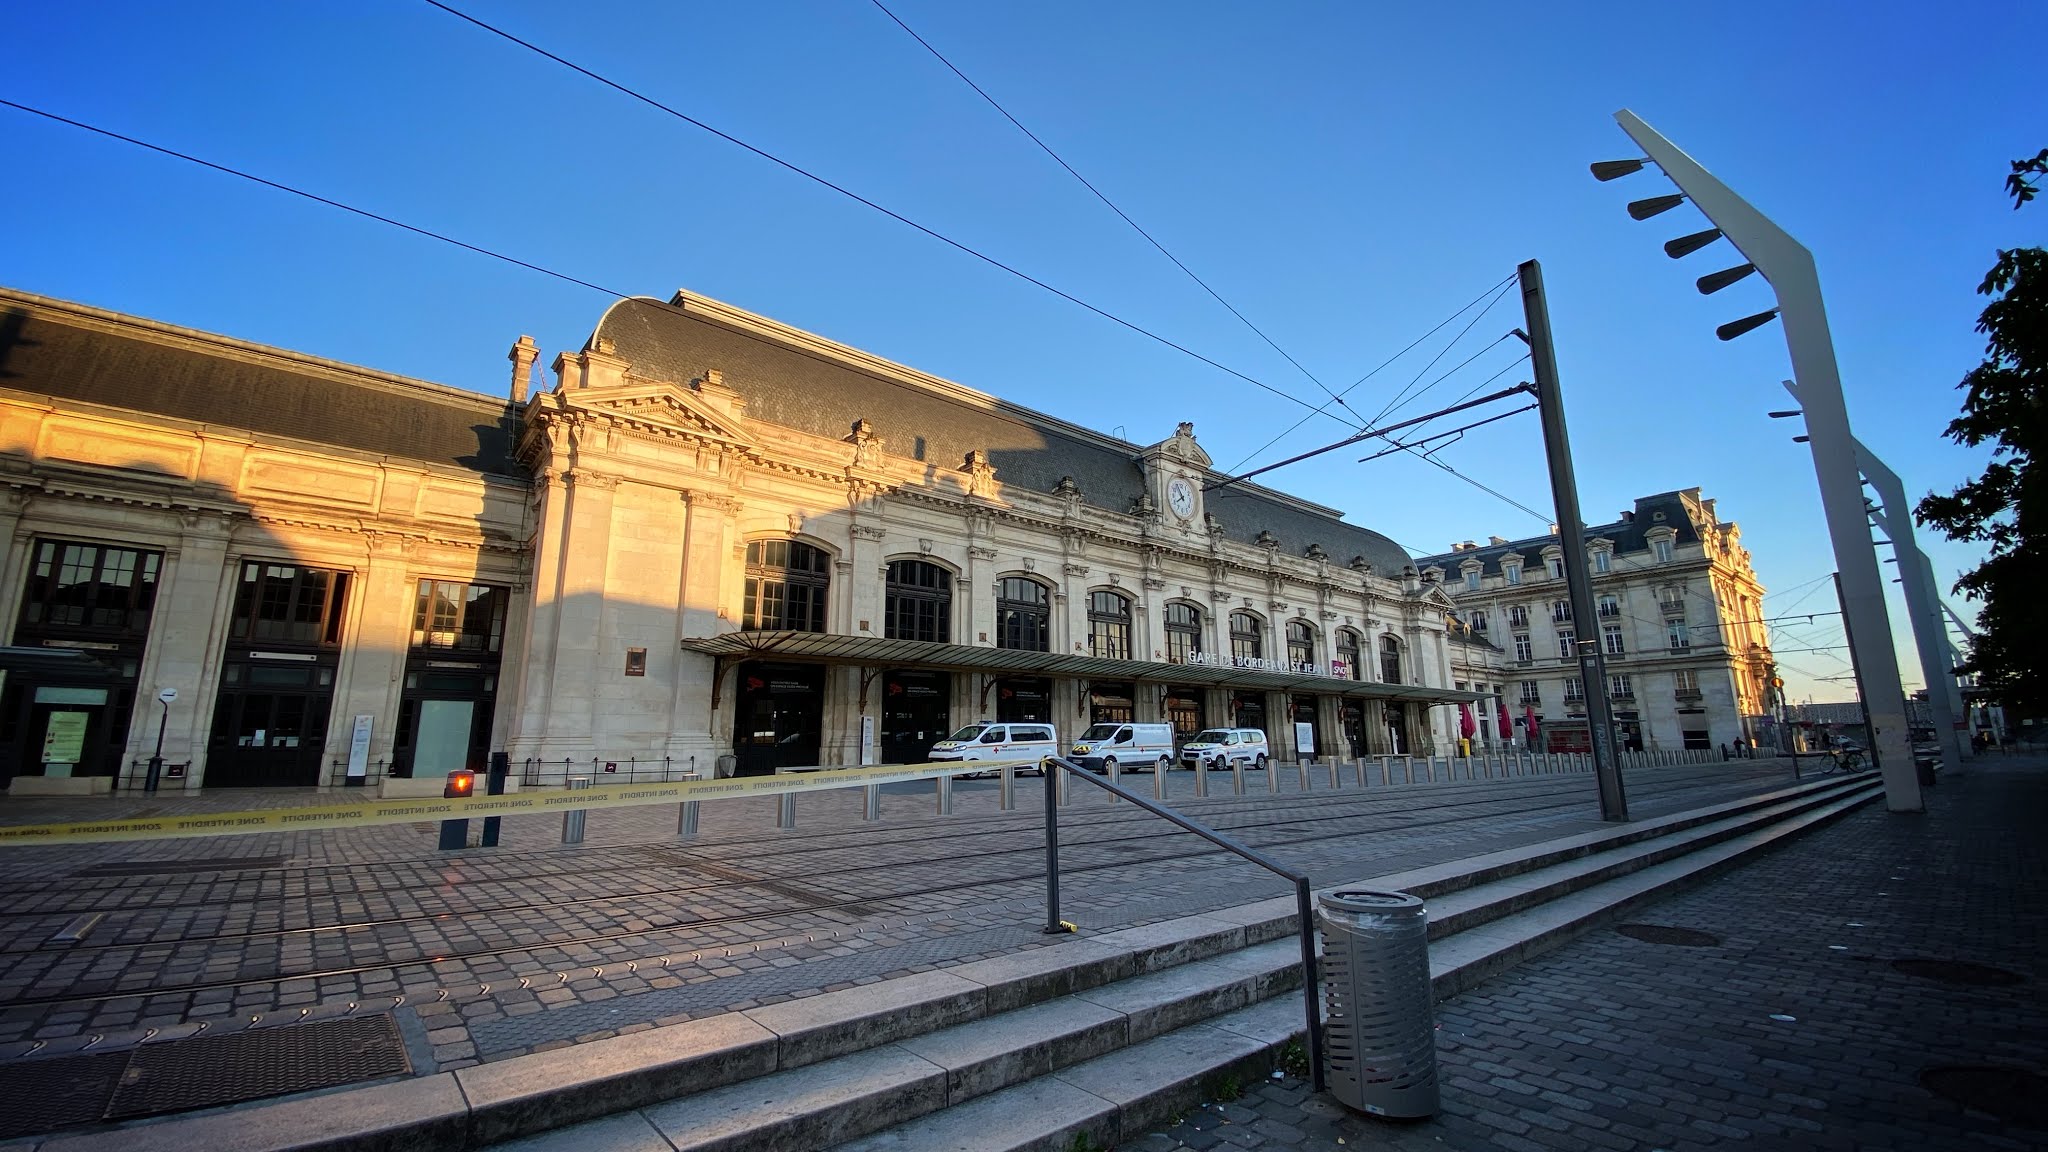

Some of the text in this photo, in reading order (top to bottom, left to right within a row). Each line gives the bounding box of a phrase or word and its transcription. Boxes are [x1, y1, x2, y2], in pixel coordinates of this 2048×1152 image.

[1188, 651, 1218, 665] GARE
[1220, 655, 1235, 667] DE
[1237, 656, 1289, 673] BORDEAUX
